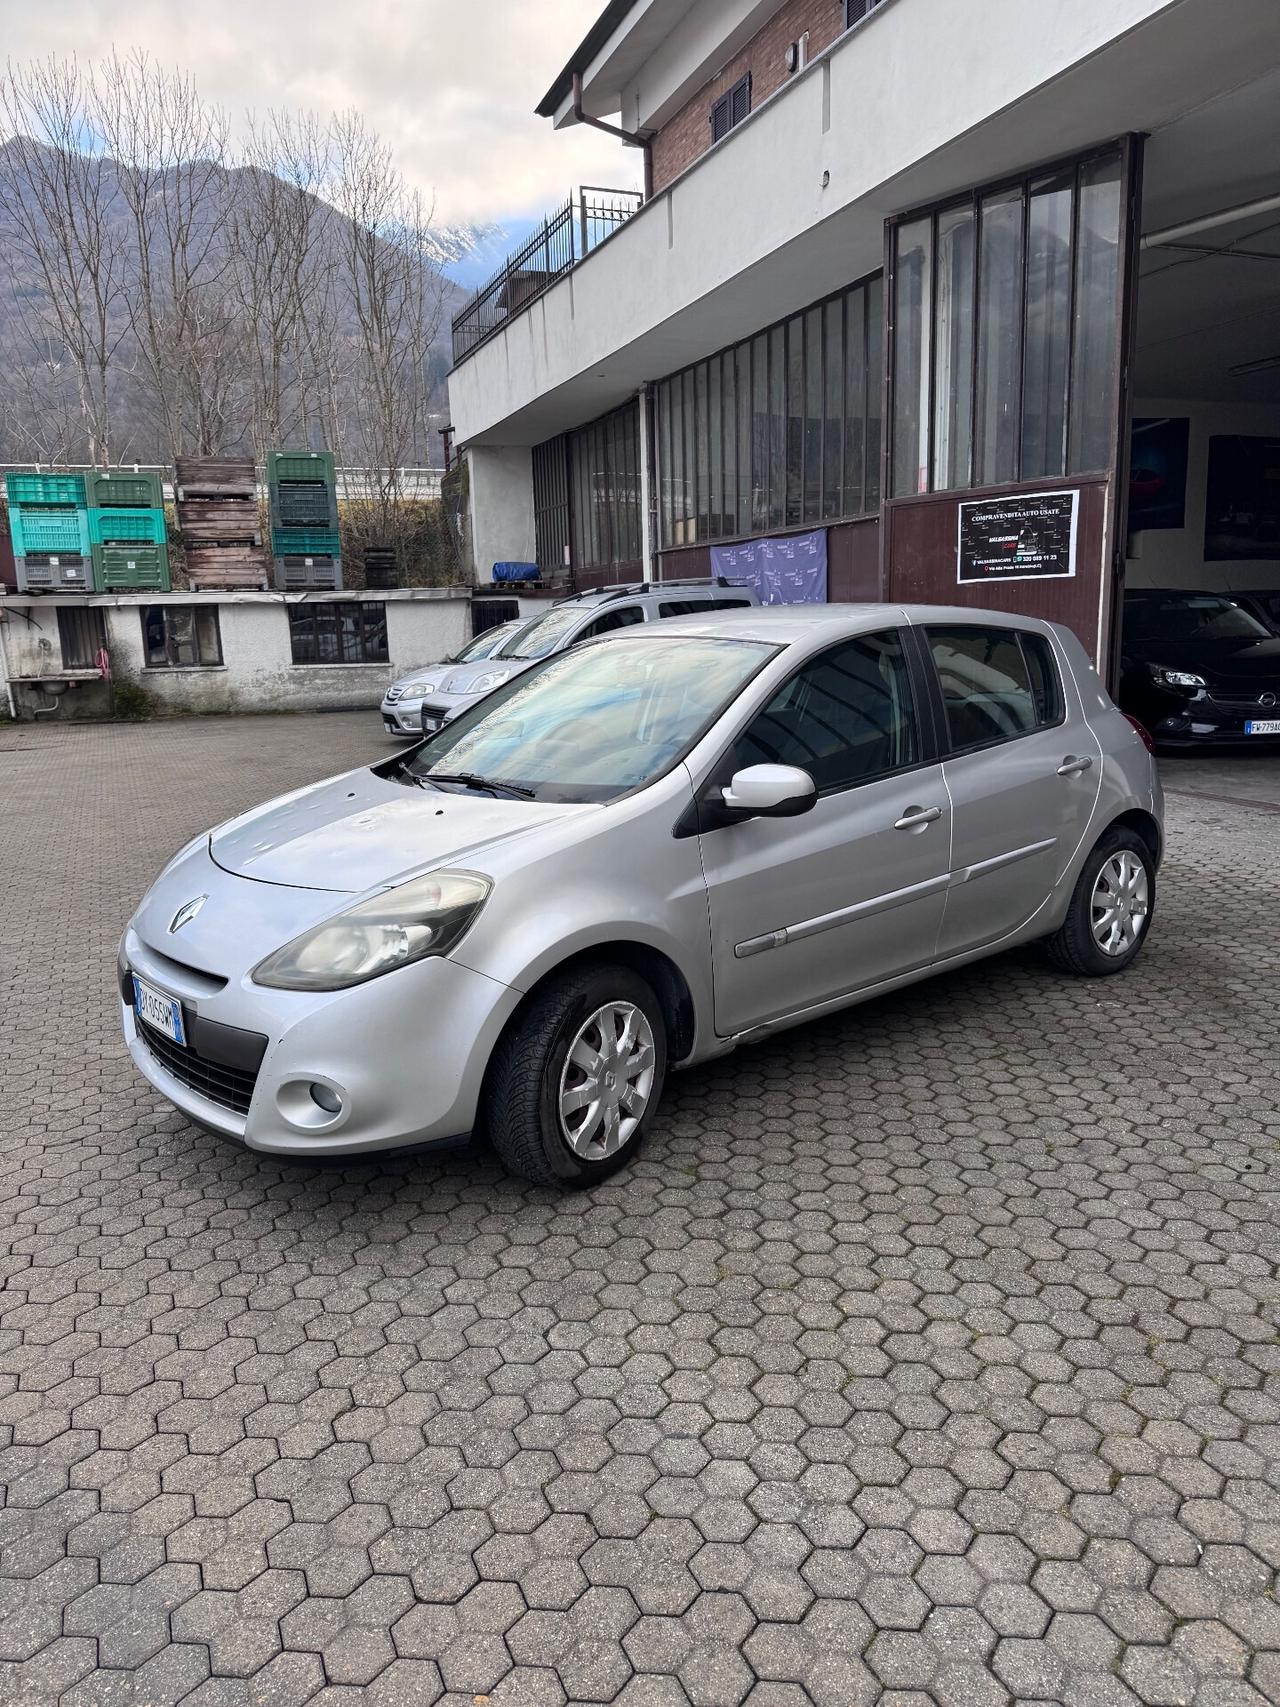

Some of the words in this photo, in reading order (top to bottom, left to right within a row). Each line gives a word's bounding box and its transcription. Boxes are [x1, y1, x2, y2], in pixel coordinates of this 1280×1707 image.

[971, 511, 1021, 522] COMPRAVENDITA
[1021, 509, 1040, 518] AUTO
[1040, 508, 1060, 516] USATE
